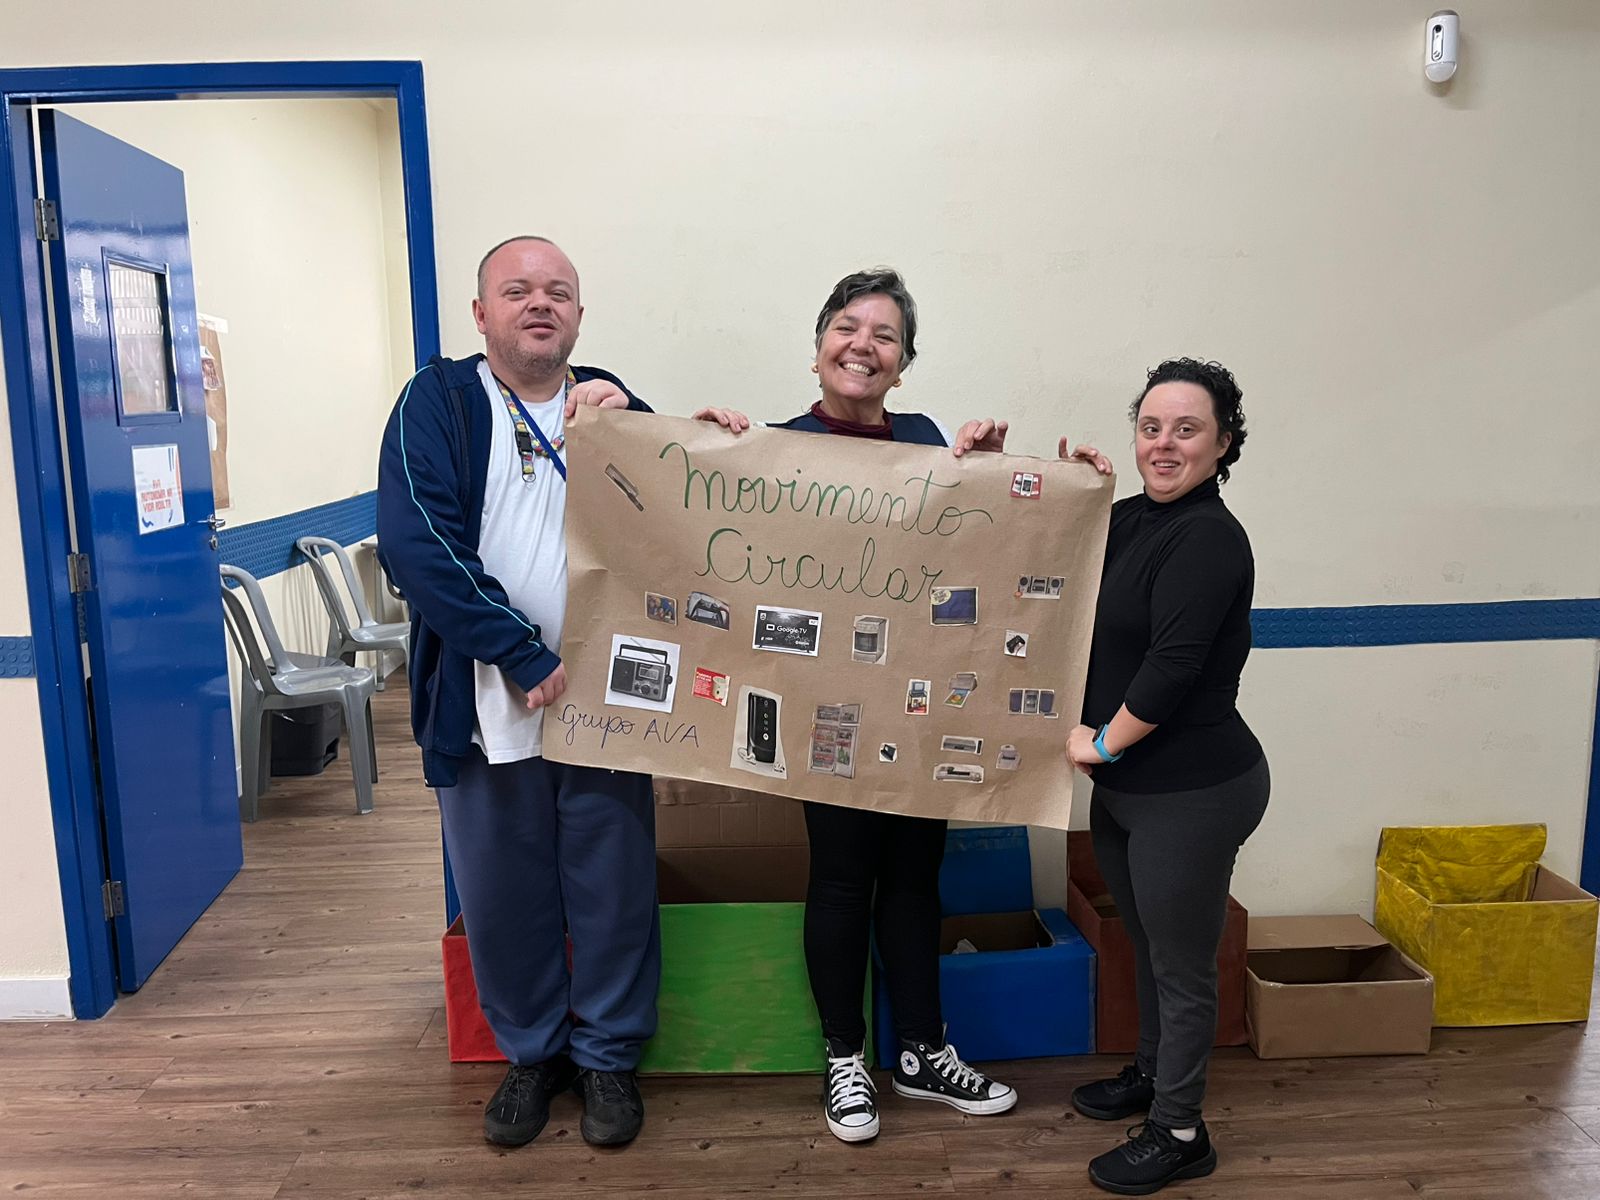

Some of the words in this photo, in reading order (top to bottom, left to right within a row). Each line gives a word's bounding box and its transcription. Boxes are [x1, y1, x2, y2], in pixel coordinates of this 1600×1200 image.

[659, 442, 993, 536] Movimento
[695, 528, 943, 602] Circular
[777, 625, 800, 634] Google
[643, 718, 699, 748] AVA
